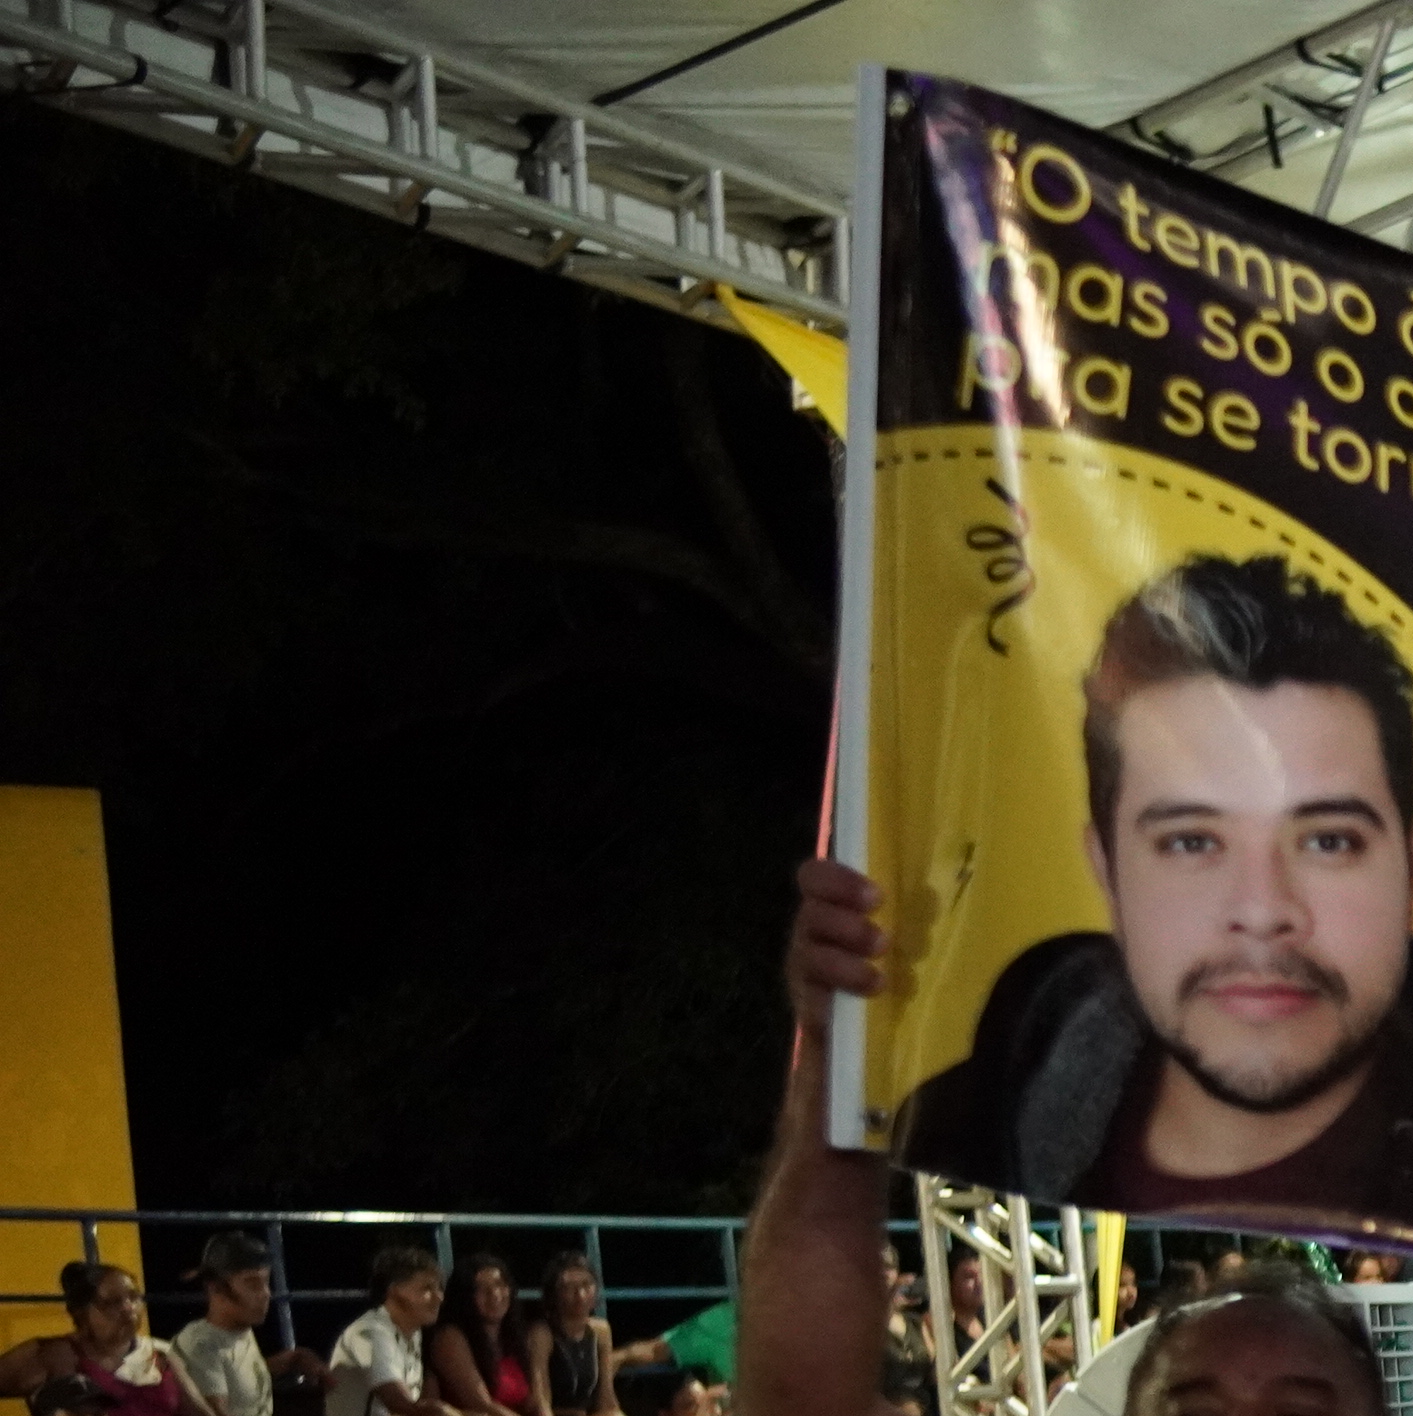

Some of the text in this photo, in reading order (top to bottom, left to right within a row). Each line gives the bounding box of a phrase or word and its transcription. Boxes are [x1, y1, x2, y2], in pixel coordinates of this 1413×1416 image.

[978, 238, 1170, 340] mas
[1200, 306, 1293, 377] só
[1316, 349, 1365, 403] o
[1118, 183, 1377, 336] tempo
[1162, 378, 1261, 451] se
